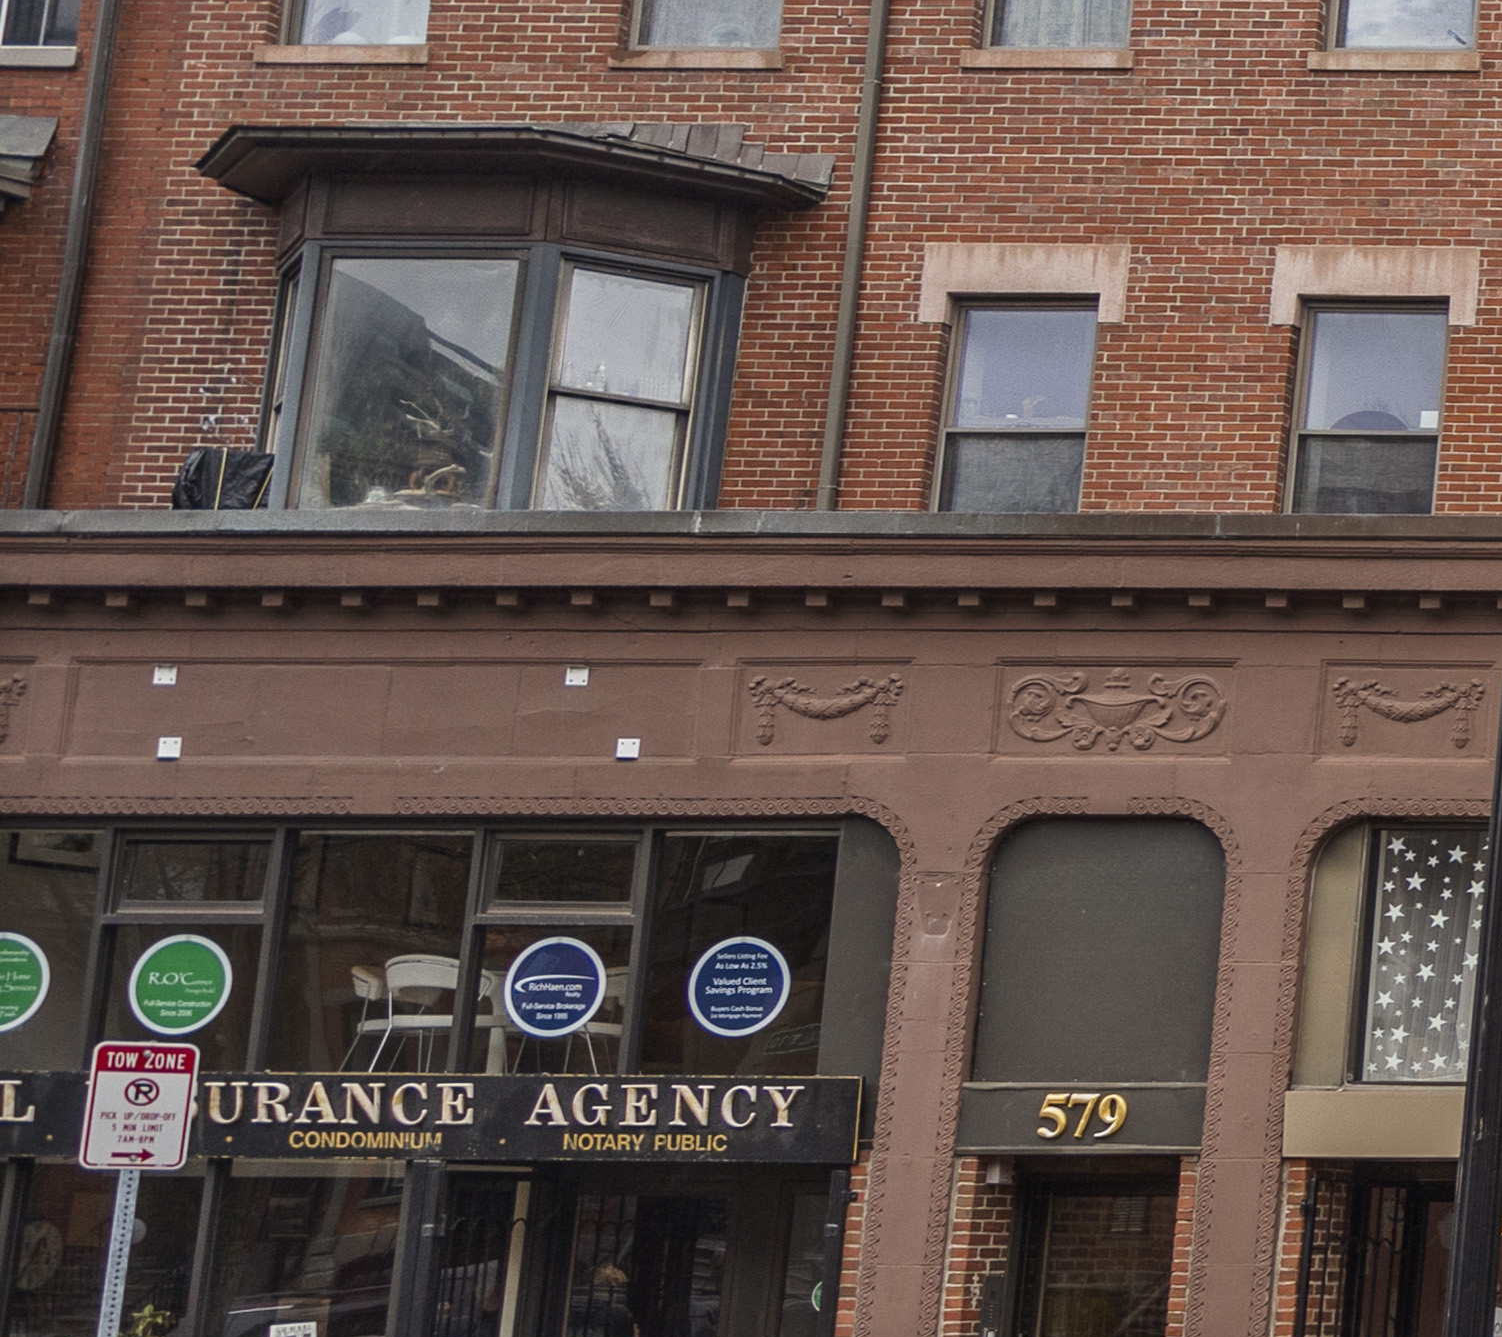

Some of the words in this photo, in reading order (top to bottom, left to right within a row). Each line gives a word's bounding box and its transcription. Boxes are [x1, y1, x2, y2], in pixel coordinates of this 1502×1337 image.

[713, 977, 741, 985] Valued
[742, 977, 767, 985] Client
[528, 982, 583, 991] RichHaen.com
[705, 986, 736, 996] Savings
[737, 986, 773, 995] Program
[107, 1051, 139, 1069] TOW
[144, 1052, 187, 1070] ZONE
[196, 1081, 474, 1126] URANCE
[523, 1083, 805, 1128] AGENCY
[100, 1111, 116, 1120] PICK
[123, 1111, 176, 1121] UP/DROP-OFF
[1036, 1092, 1128, 1139] 579
[112, 1124, 116, 1132] 5
[122, 1124, 137, 1132] MIN
[142, 1124, 163, 1133] LIMIT
[289, 1131, 443, 1150] CONDOMINIUM
[563, 1132, 645, 1151] NOTARY
[654, 1134, 728, 1152] PUBLIC
